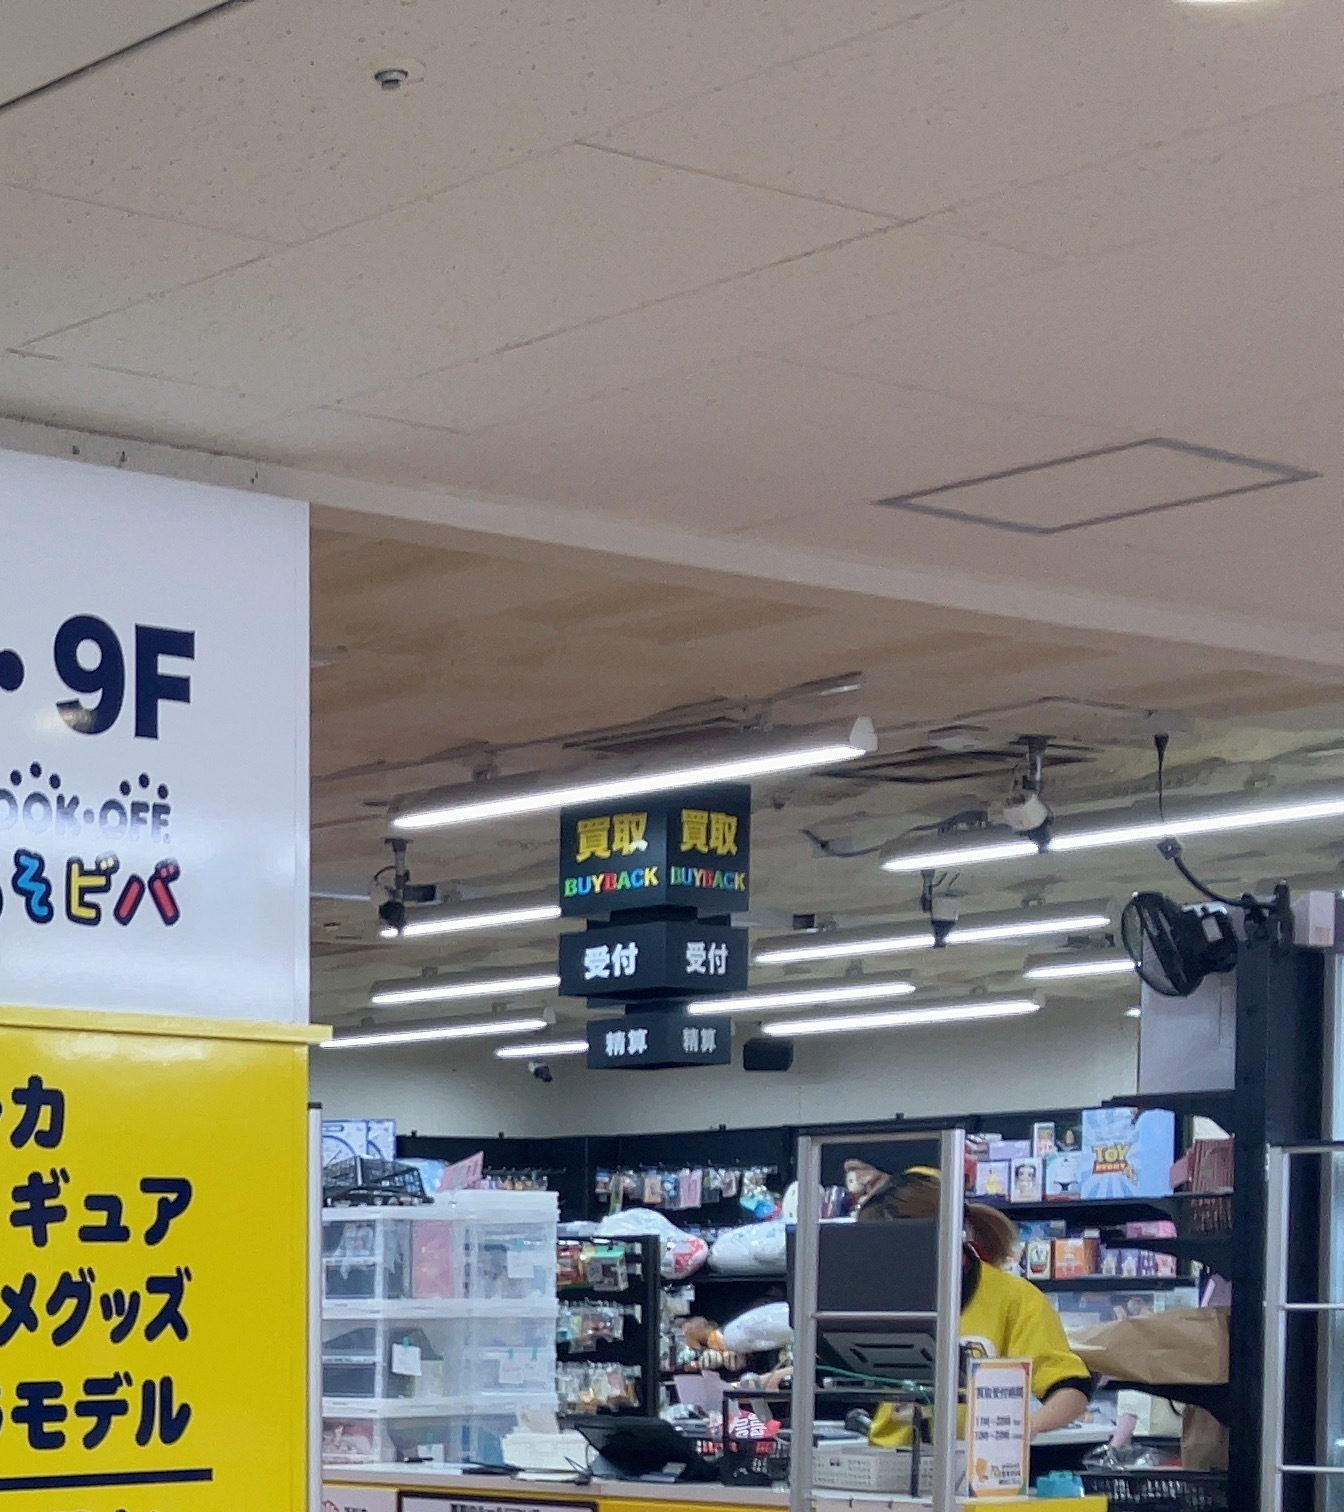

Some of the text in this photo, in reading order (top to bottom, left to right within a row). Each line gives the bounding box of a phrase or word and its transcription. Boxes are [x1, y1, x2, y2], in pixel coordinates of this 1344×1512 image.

[575, 811, 649, 863] 買取
[680, 807, 739, 857] 買取
[564, 866, 659, 898] BUYBACK
[670, 865, 746, 892] BUYBACK
[583, 942, 639, 981] 受付
[685, 941, 729, 976] 受付
